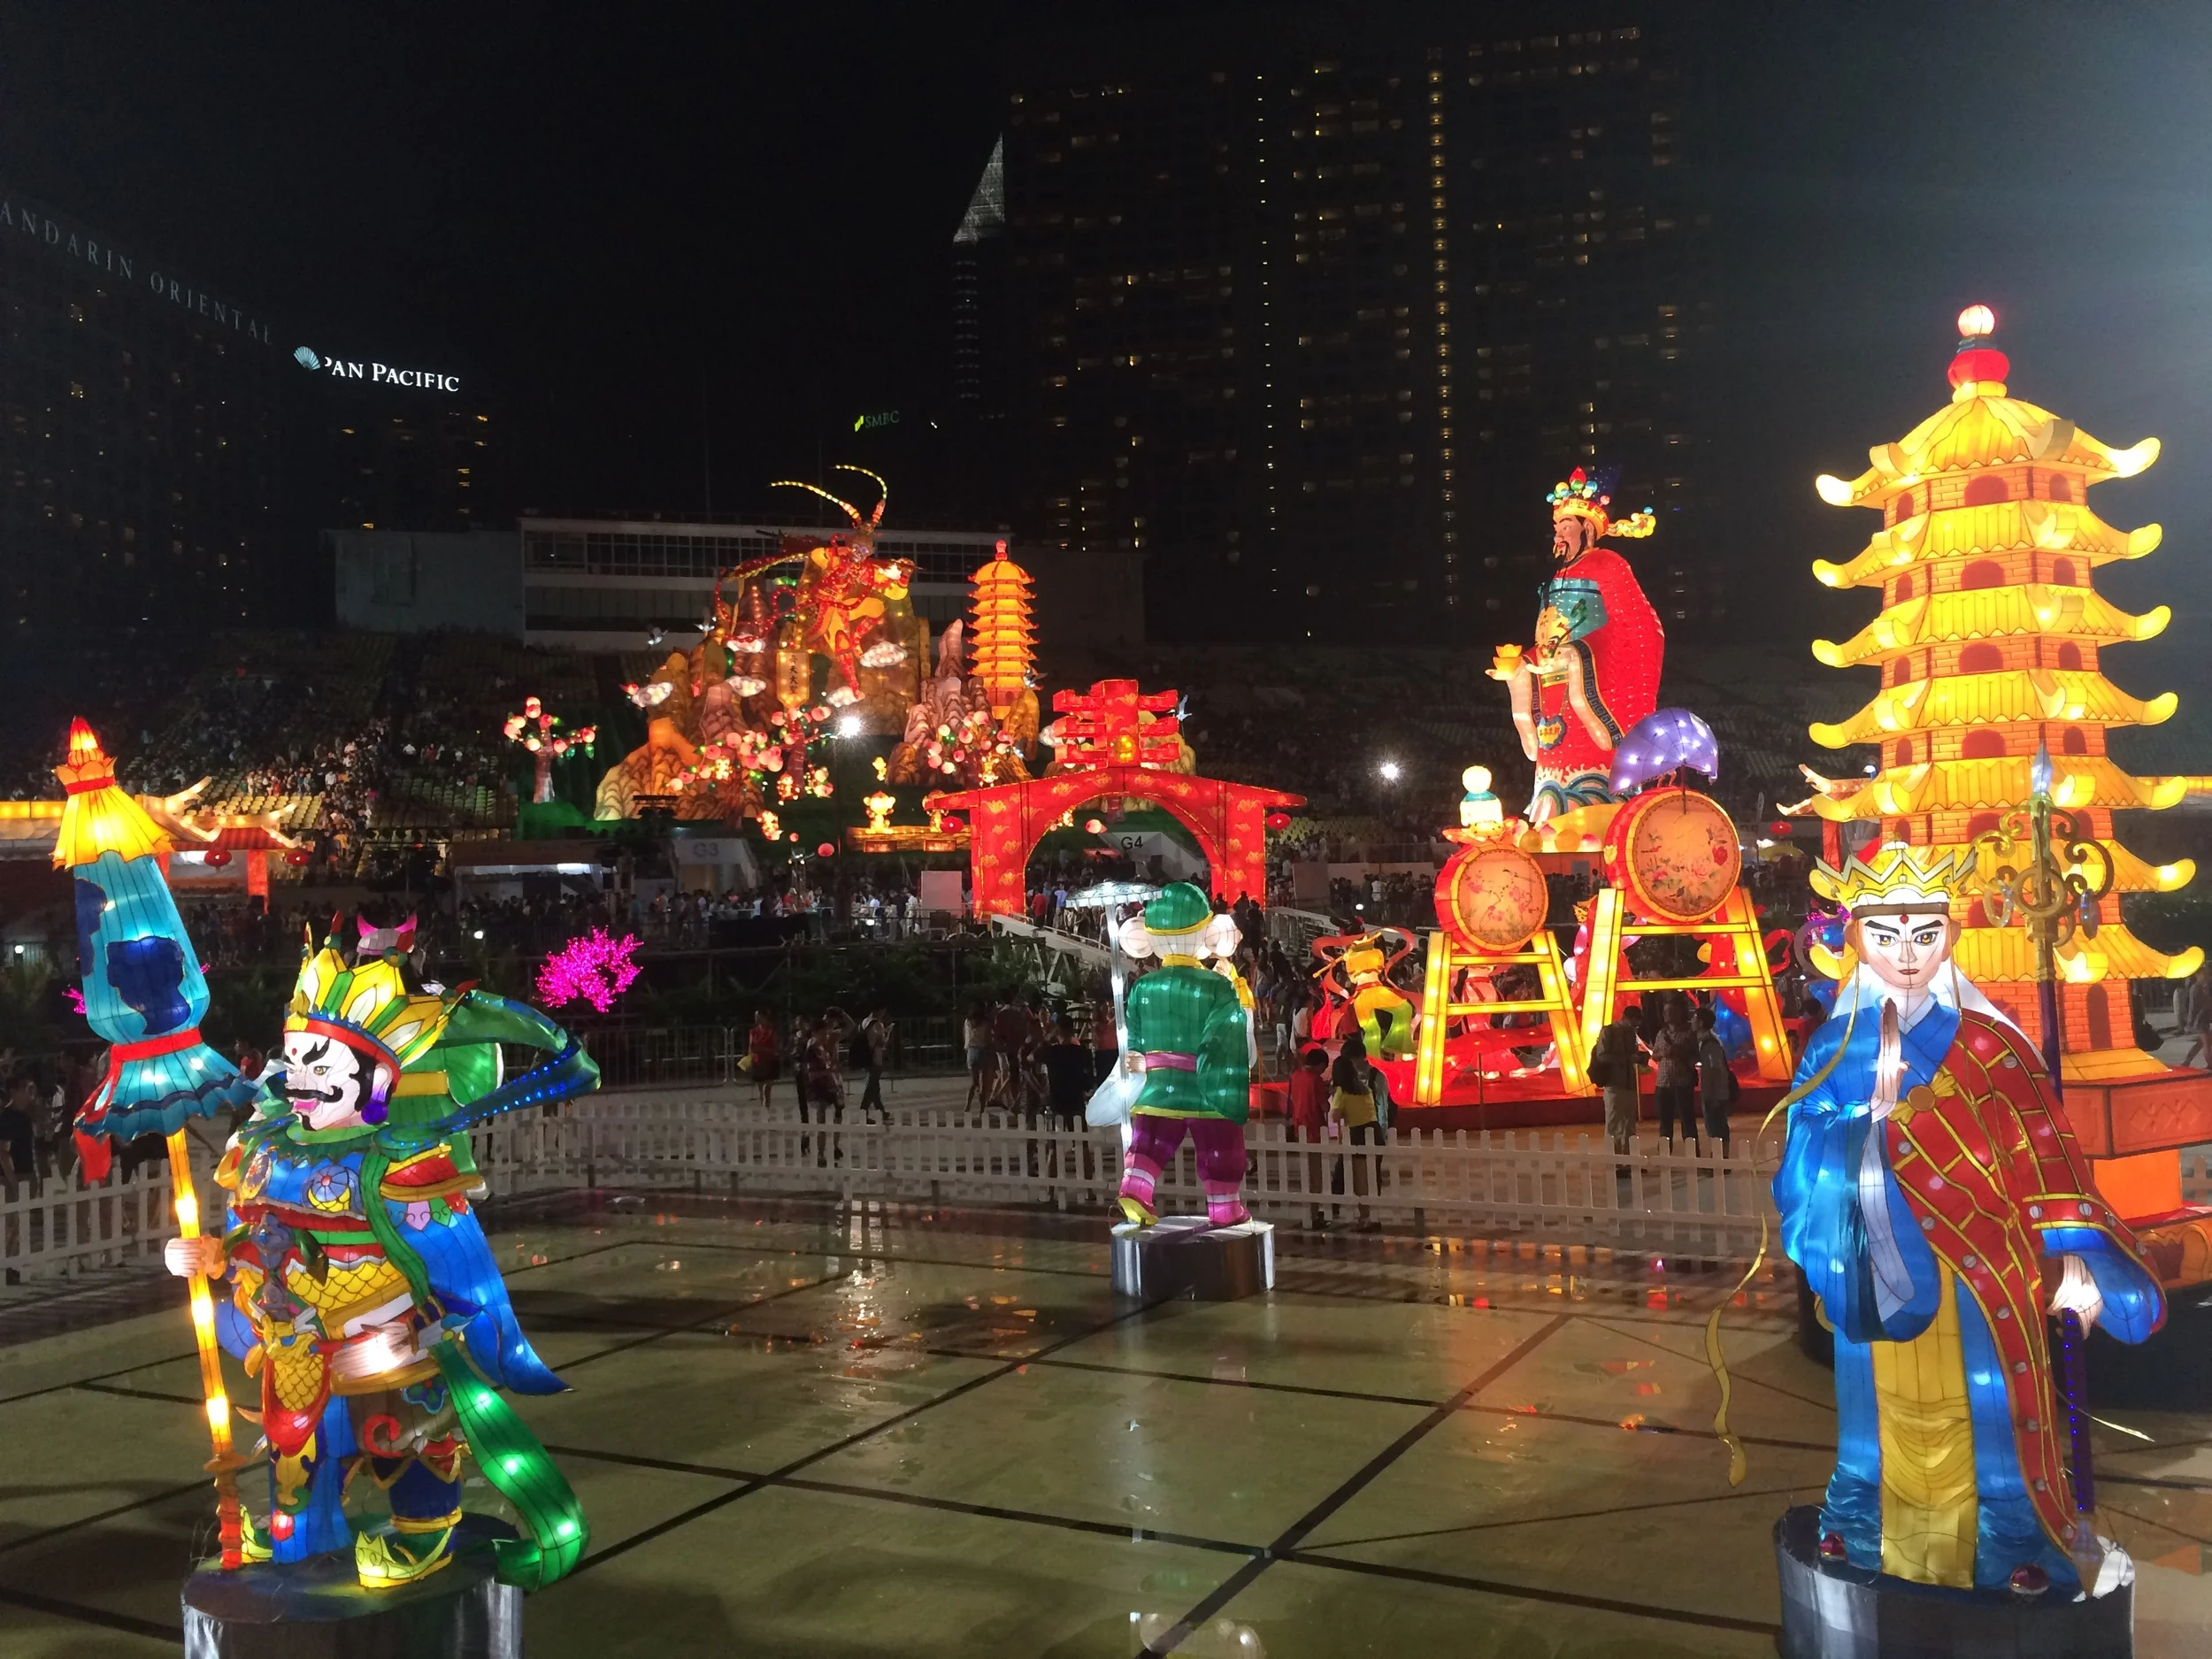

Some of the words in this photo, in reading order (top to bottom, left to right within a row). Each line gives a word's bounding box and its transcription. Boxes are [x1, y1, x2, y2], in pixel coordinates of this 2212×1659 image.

[150, 272, 273, 347] ORIENTAL
[372, 362, 460, 392] PACIFIC
[694, 842, 719, 857] G3
[1121, 835, 1143, 850] G4
